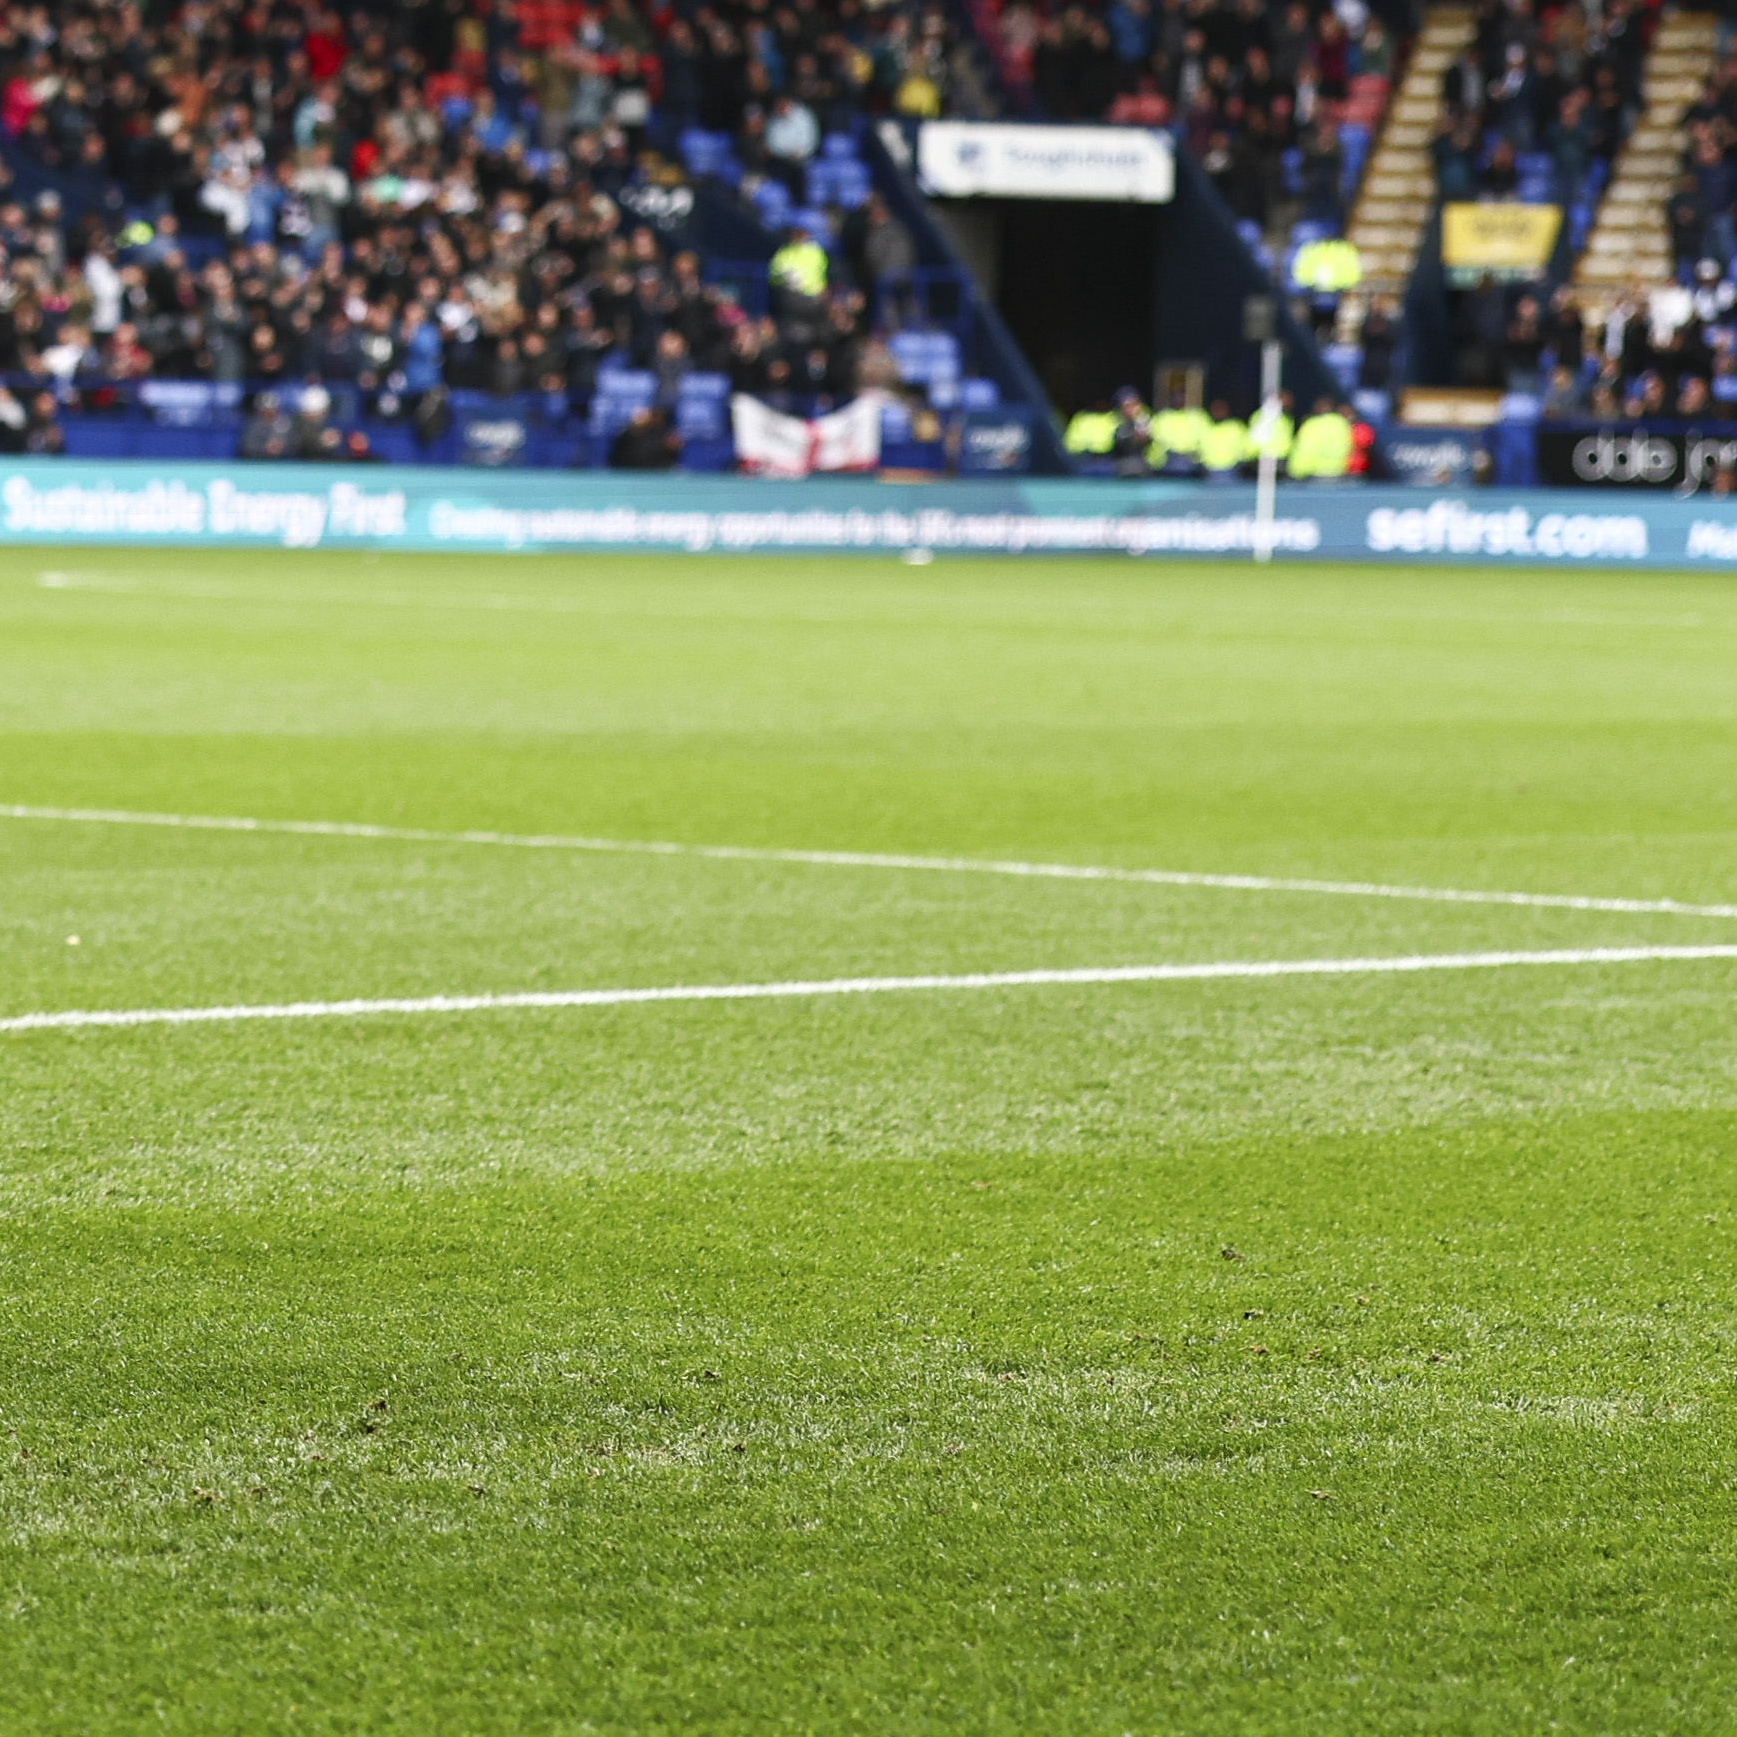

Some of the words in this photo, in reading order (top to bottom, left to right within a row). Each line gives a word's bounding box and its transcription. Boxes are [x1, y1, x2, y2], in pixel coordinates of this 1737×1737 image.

[2, 475, 206, 534] Sustainable
[207, 478, 327, 549] Energy
[329, 480, 407, 537] First
[1366, 499, 1650, 560] sefirst.com
